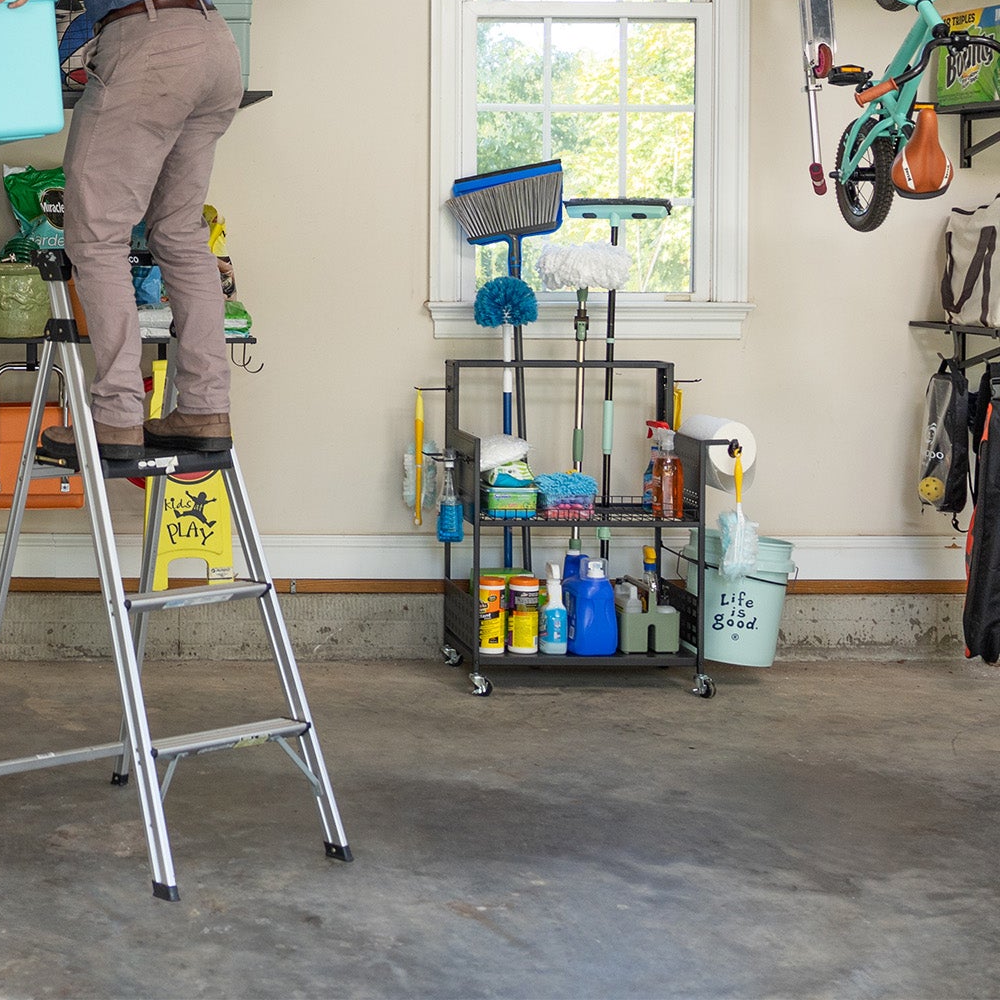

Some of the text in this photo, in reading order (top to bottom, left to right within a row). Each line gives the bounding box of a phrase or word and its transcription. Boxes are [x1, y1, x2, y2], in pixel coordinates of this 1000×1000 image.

[952, 13, 976, 27] TRIPLES
[164, 497, 192, 511] kids
[166, 520, 214, 546] PLAY
[720, 591, 754, 608] Life
[731, 606, 746, 618] is
[712, 613, 759, 631] good.
